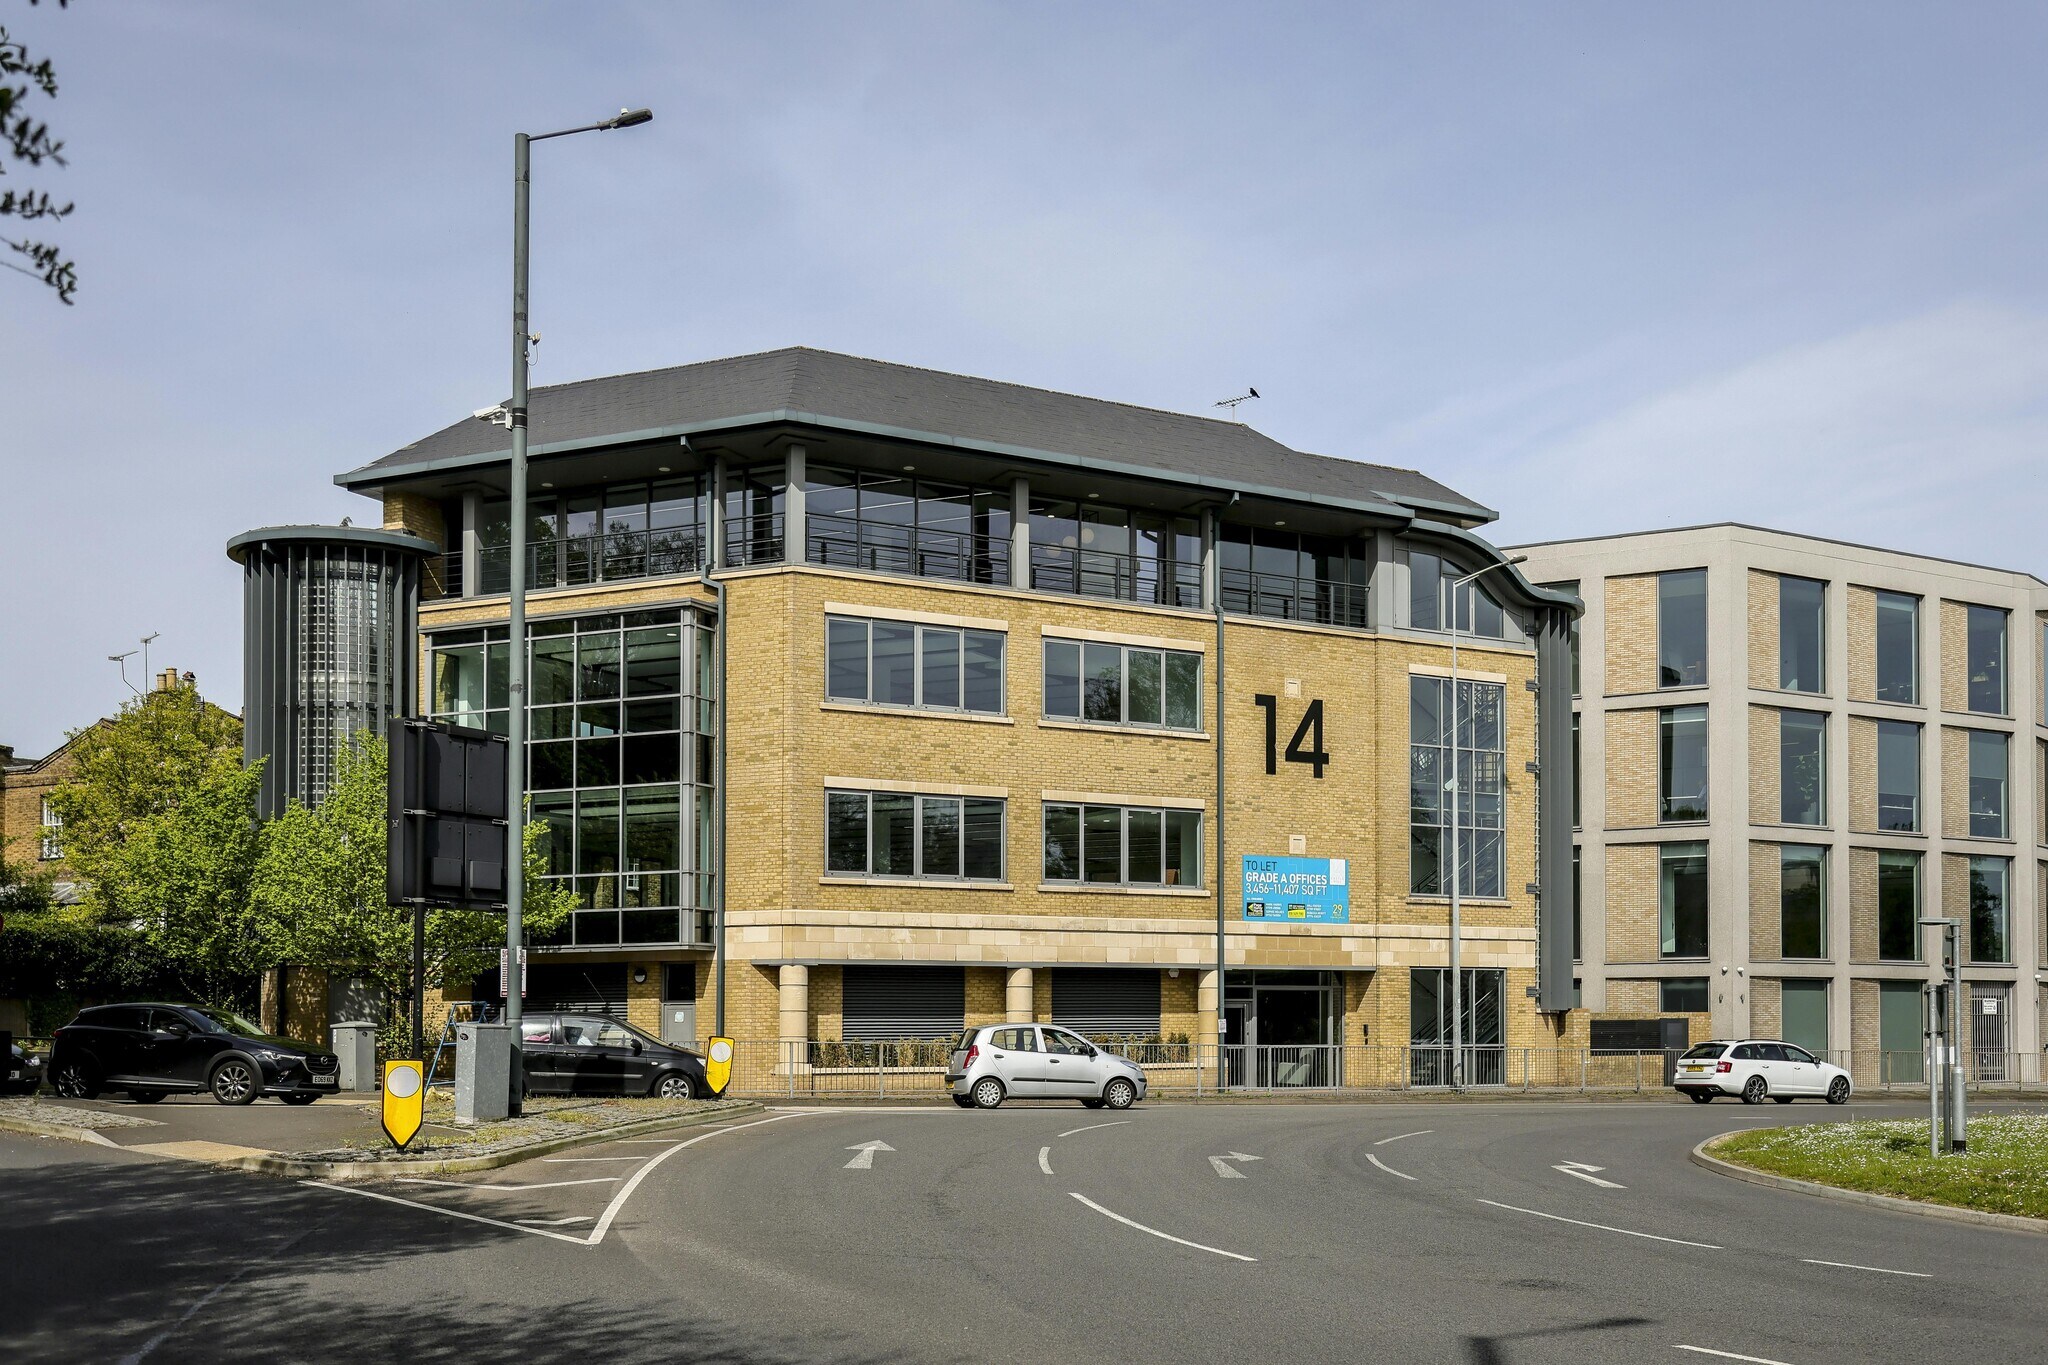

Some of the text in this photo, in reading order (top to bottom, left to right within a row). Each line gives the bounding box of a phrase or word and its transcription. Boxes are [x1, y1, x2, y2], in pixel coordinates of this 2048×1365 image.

[1255, 694, 1329, 779] 14
[1246, 861, 1277, 871] TO LET
[1246, 872, 1327, 885] GRADE A OFFICES
[1302, 886, 1314, 895] SQ
[1316, 886, 1327, 895] FT
[1332, 904, 1343, 914] 29
